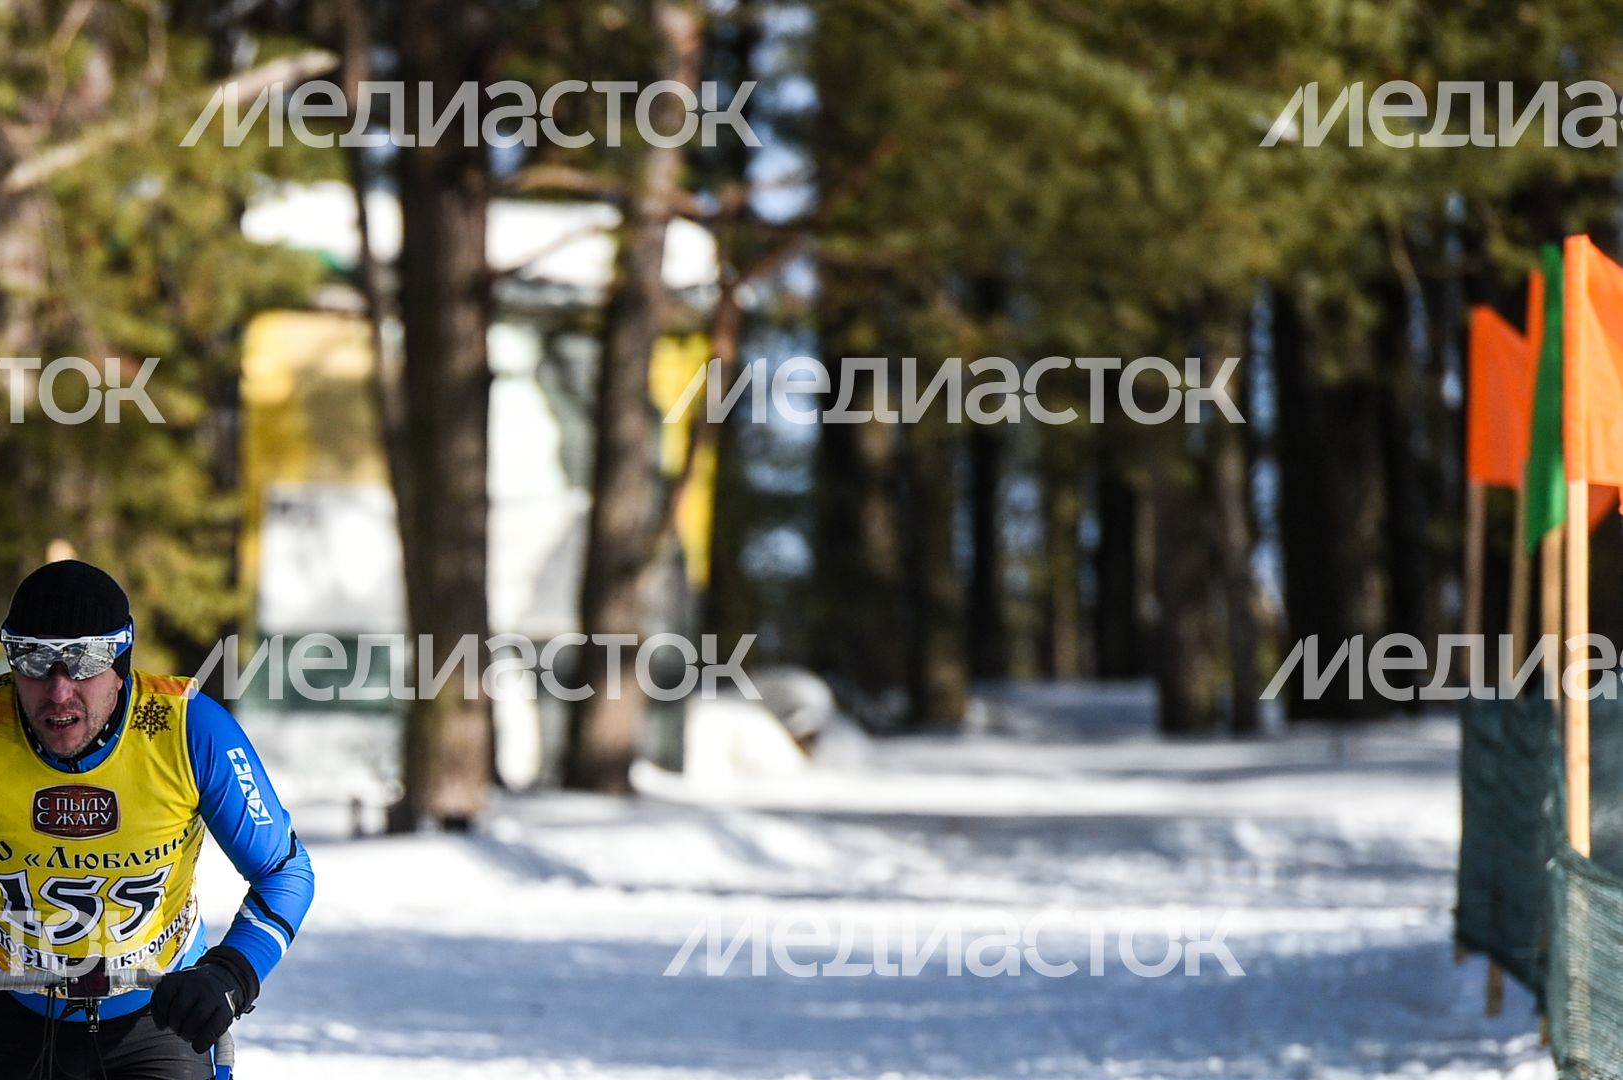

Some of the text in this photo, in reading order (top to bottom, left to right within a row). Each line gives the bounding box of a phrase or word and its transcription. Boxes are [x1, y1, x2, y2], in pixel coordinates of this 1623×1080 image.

[37, 797, 112, 811] С ПЫЛУ
[37, 812, 112, 826] С ЖАРУ
